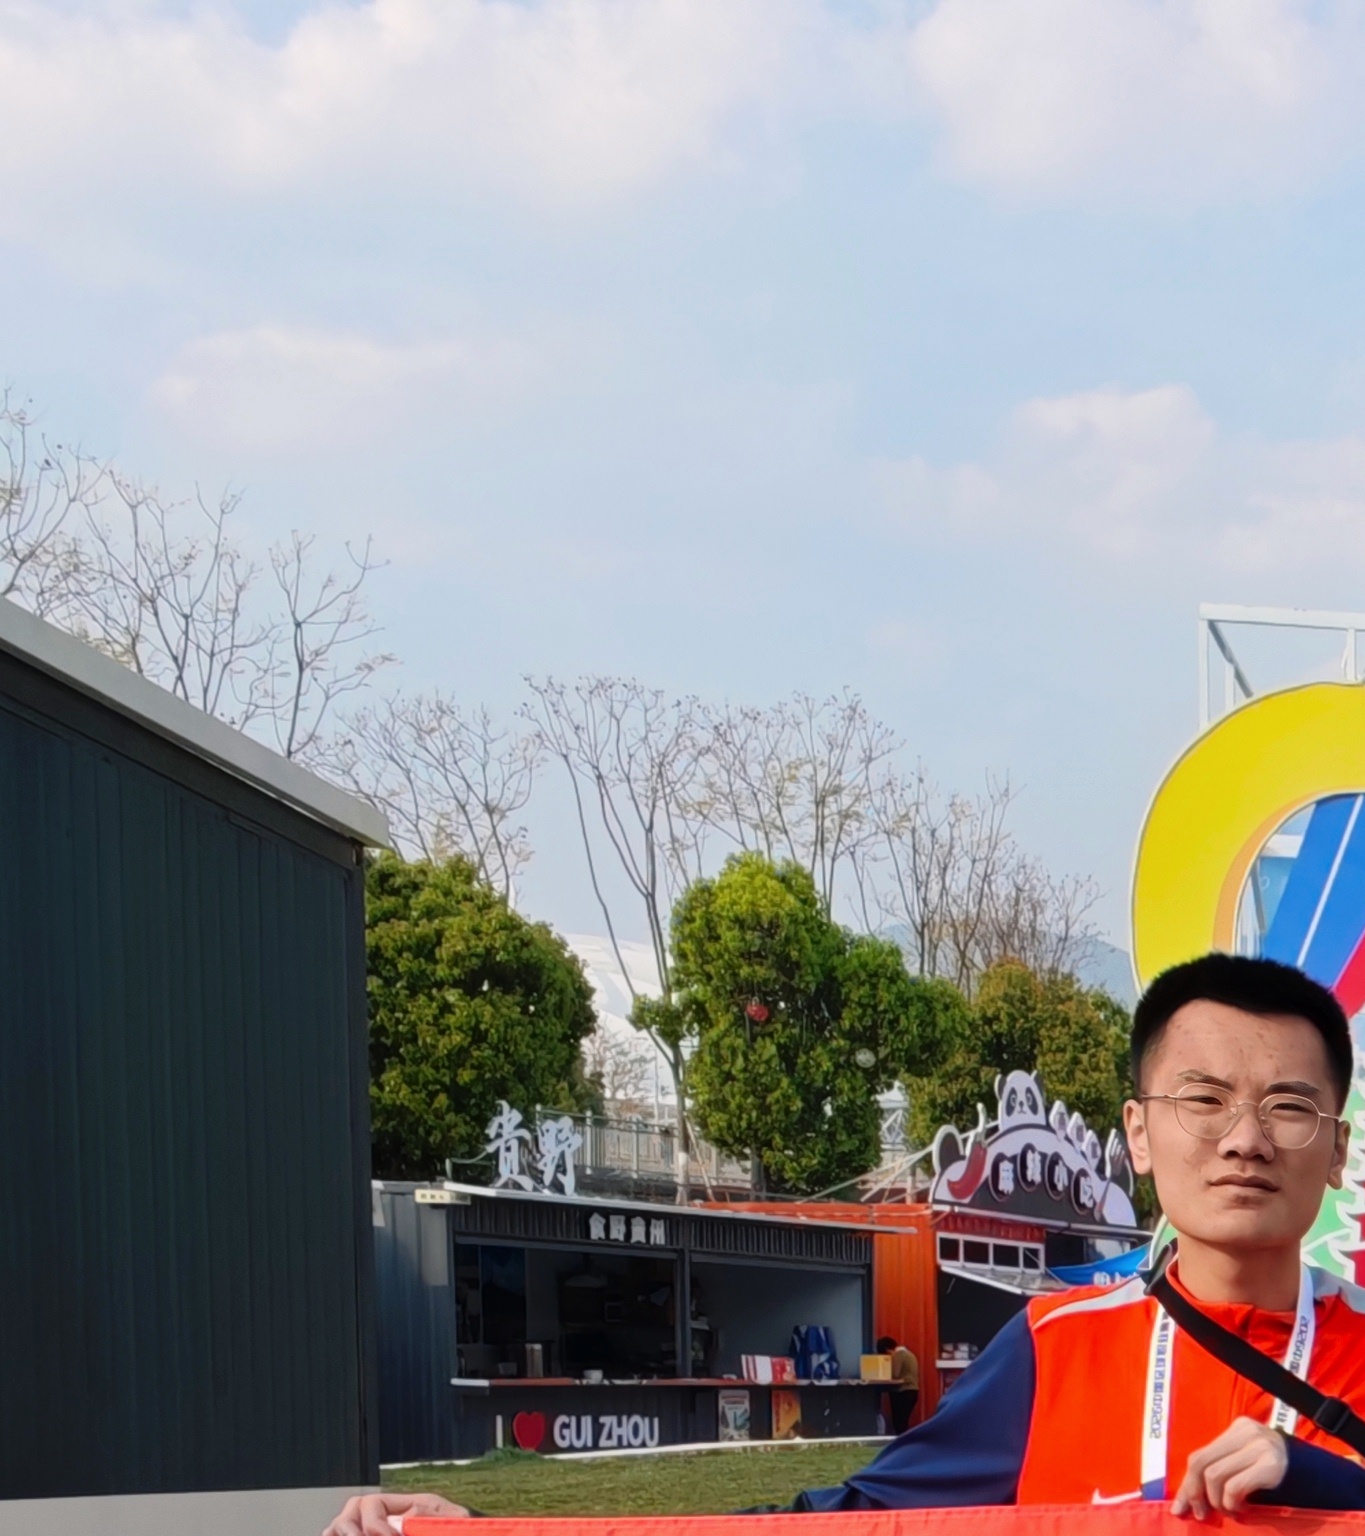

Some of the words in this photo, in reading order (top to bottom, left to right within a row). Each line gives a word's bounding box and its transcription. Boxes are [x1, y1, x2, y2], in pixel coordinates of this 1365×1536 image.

[495, 1414, 503, 1448] I
[553, 1414, 593, 1448] GUI
[598, 1414, 660, 1448] ZHOU
